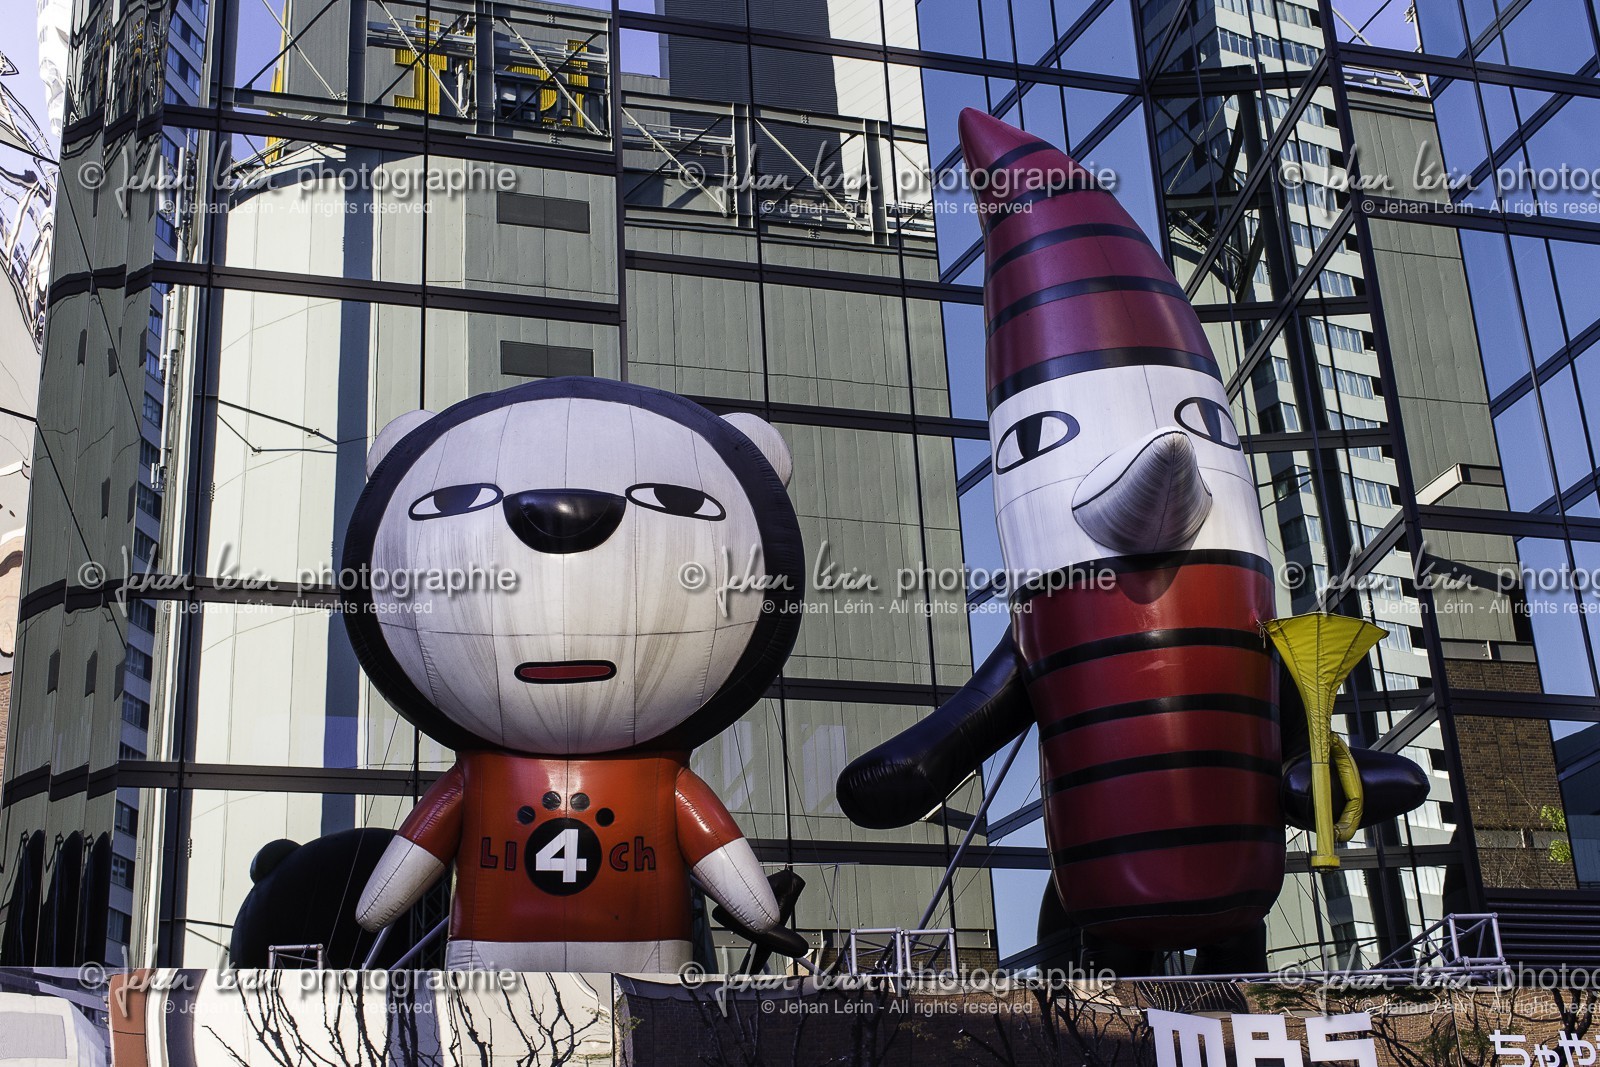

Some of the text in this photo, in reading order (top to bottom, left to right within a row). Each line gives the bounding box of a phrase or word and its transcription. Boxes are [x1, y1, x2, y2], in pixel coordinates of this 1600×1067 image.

[535, 828, 587, 883] 4
[1489, 1029, 1600, 1067] ちゃや
